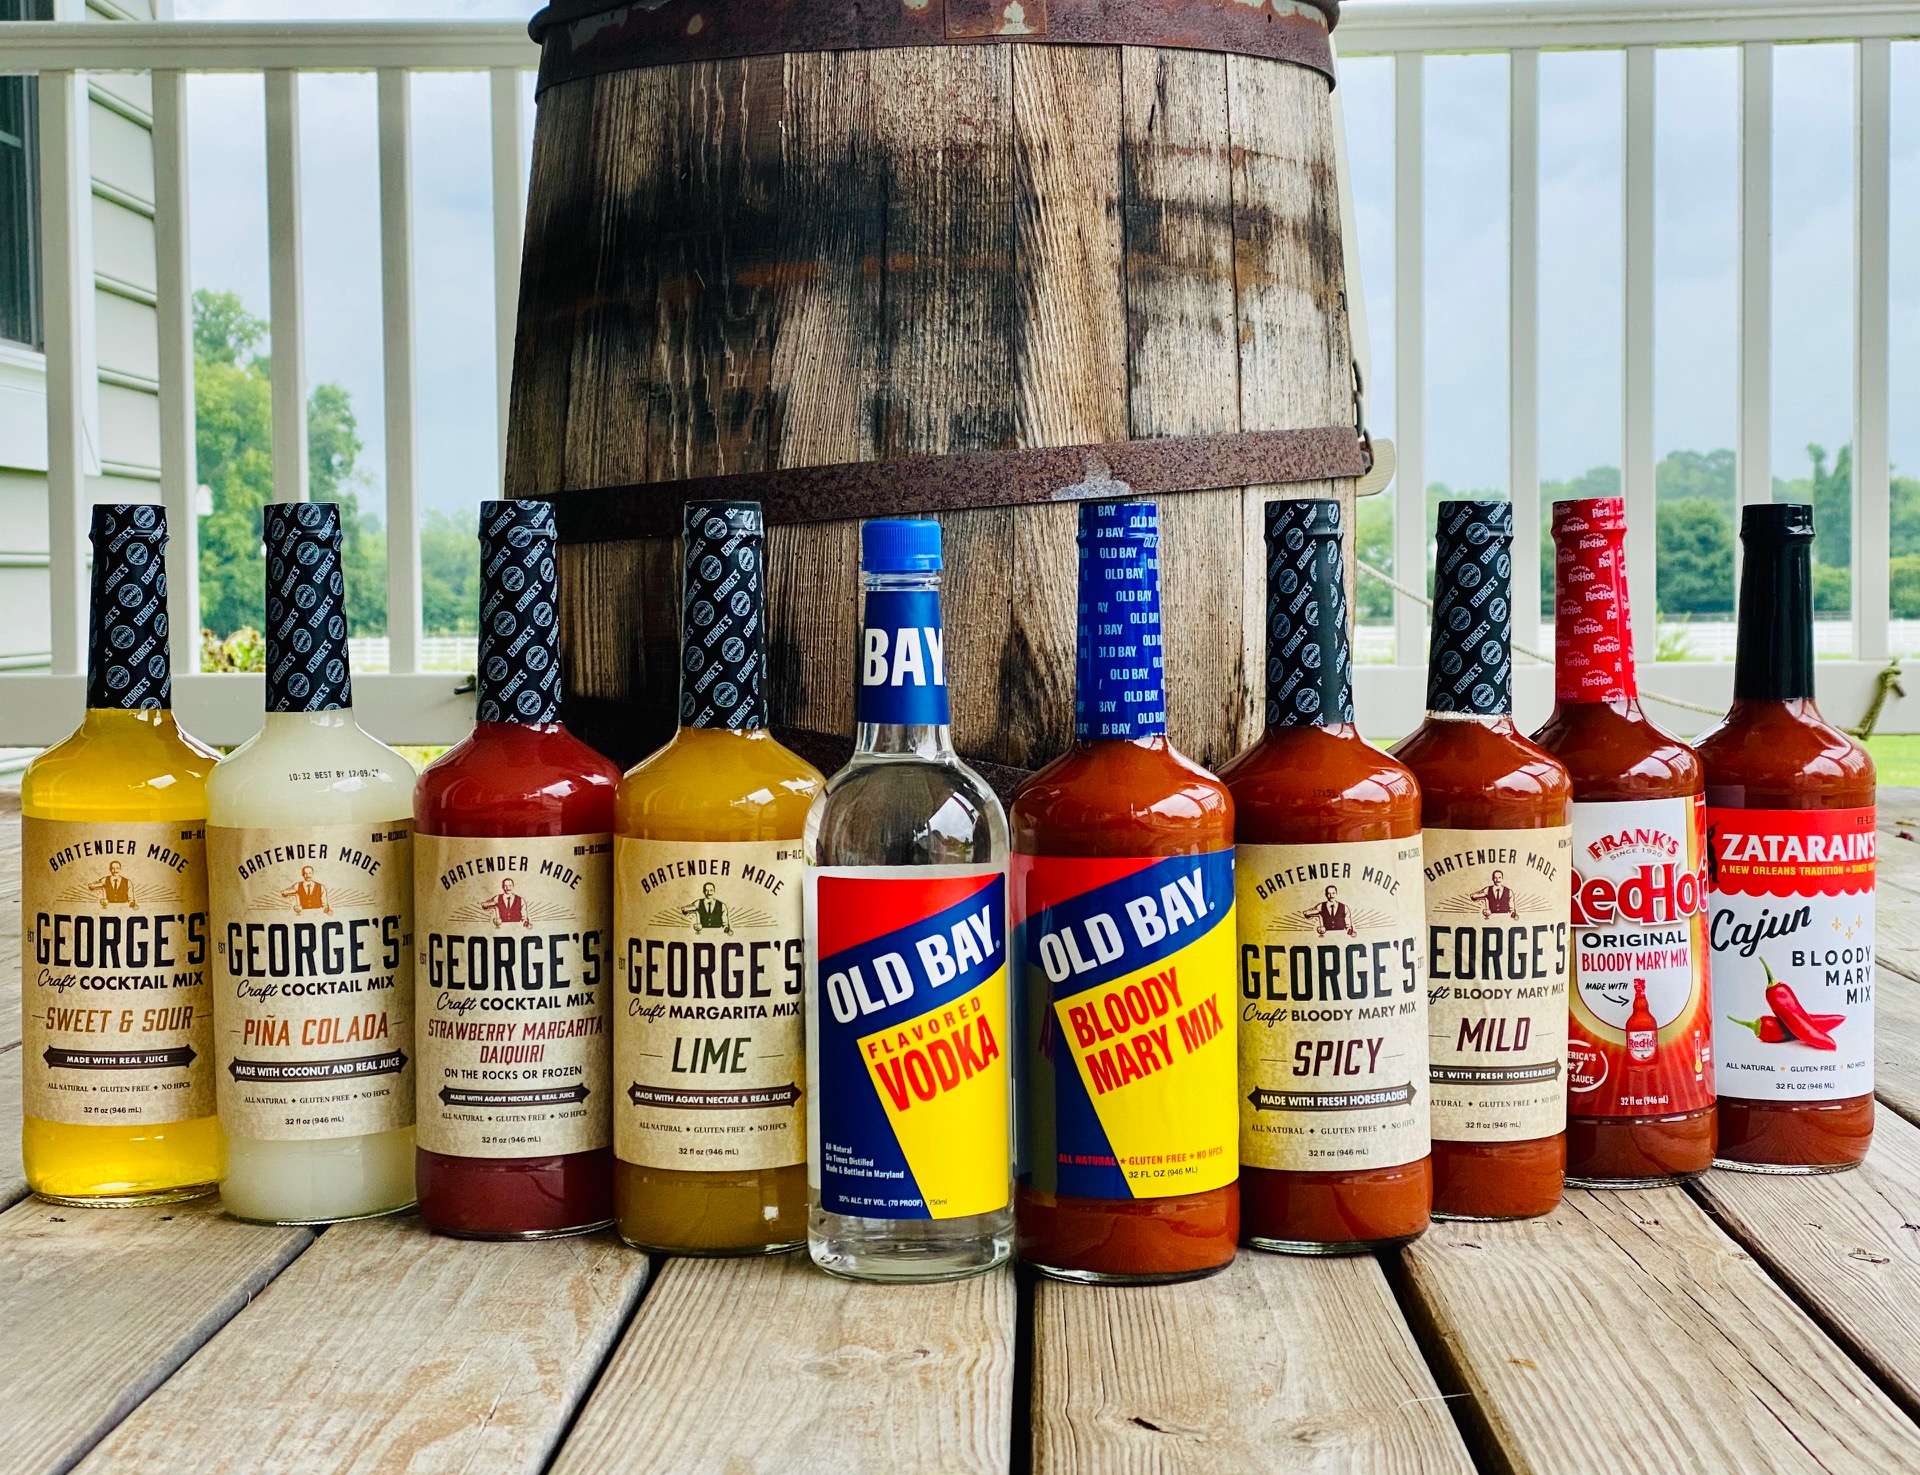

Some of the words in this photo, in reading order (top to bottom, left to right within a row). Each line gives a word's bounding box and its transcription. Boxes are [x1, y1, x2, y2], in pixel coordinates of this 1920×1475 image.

[1100, 548, 1117, 558] OLD
[1119, 547, 1137, 558] BAY
[312, 551, 336, 584] GEORGE'S
[515, 580, 543, 613] GEORGE'S
[713, 569, 741, 602] GEORGE'S
[863, 627, 943, 686] BAY
[1110, 669, 1129, 680] OLD
[1132, 668, 1148, 679] BAY
[289, 773, 310, 781] 10:32
[315, 771, 331, 779] BEST
[49, 840, 136, 872] BARTENDER
[147, 844, 189, 873] MADE
[1587, 828, 1679, 861] FRANK'S
[1610, 849, 1637, 860] SINCE
[1642, 848, 1662, 858] 1920
[238, 844, 328, 879] BARTENDER
[339, 847, 381, 876] MADE
[441, 856, 528, 890] BARTENDER
[540, 859, 582, 890] MADE
[1424, 849, 1517, 882] BARTENDER
[1526, 852, 1557, 882] MADE
[1730, 865, 1749, 874] NEW
[1753, 866, 1796, 875] ORLEANS
[1800, 866, 1843, 875] TRADITION
[641, 860, 730, 894] BARTENDER
[742, 864, 784, 896] MADE
[1256, 862, 1351, 900] BARTENDER
[1362, 866, 1400, 896] MADE
[1039, 912, 1124, 982] OLD
[1125, 867, 1208, 948] BAY
[1711, 905, 1811, 957] Cajun
[37, 912, 206, 968] GEORGE'S
[228, 915, 400, 977] GEORGE'S
[1429, 922, 1566, 980] EORGE'S
[1582, 931, 1687, 948] ORIGINAL
[429, 930, 600, 991] GEORGE'S
[628, 937, 802, 998] GEORGE'S
[826, 952, 914, 1024] OLD
[915, 904, 995, 989] BAY
[1241, 937, 1415, 1001] GEORGE'S
[1582, 953, 1632, 972] BLOODY
[1636, 951, 1667, 971] MARY
[1671, 948, 1688, 967] MIX
[1792, 946, 1871, 967] BLOODY
[38, 969, 76, 993] Craft
[80, 975, 168, 990] COCKTAIL
[173, 971, 204, 987] MIX
[237, 980, 278, 1003] Craft
[282, 980, 362, 996] COCKTAIL
[367, 975, 395, 991] MIX
[1826, 966, 1871, 986] MARY
[437, 992, 476, 1016] Craft
[480, 996, 561, 1010] COCKTAIL
[567, 992, 595, 1007] MIX
[1427, 986, 1450, 1004] aft
[1454, 988, 1512, 1000] BLOODY
[1517, 986, 1549, 999] MARY
[1551, 982, 1564, 994] MIX
[1847, 986, 1870, 1005] MIX
[46, 1007, 112, 1033] SWEET
[119, 1010, 133, 1033] &
[142, 1006, 193, 1032] SOUR
[629, 998, 666, 1023] Craft
[669, 1005, 767, 1019] MARGARITA
[773, 1002, 800, 1017] MIX
[1068, 966, 1183, 1049] BLOODY
[1243, 1003, 1287, 1028] Craft
[1292, 1009, 1353, 1021] BLOODY
[1358, 1005, 1395, 1020] MARY
[1400, 1001, 1416, 1014] MIX
[243, 1015, 290, 1046] PIÑA
[301, 1012, 388, 1045] COLADA
[428, 1019, 517, 1041] STRAWBERRY
[522, 1016, 602, 1041] MARGARITA
[867, 996, 981, 1059] FLAVORED
[1456, 1017, 1531, 1052] MILD
[480, 1045, 545, 1065] DAIQUIRI
[671, 1037, 751, 1074] LIME
[1085, 1024, 1174, 1095] MARY
[1176, 993, 1224, 1054] MIX
[1292, 1037, 1384, 1076] SPICY
[1568, 1052, 1596, 1061] ERICA'S
[67, 1056, 90, 1064] MADE
[119, 1056, 141, 1064] REAL
[144, 1055, 168, 1063] JUICE
[236, 1066, 255, 1076] MADE
[257, 1067, 280, 1077] WITH
[282, 1066, 329, 1077] COCONUT
[332, 1064, 354, 1075] AND
[356, 1060, 377, 1072] REAL
[379, 1057, 399, 1069] JUICE
[445, 1068, 458, 1078] ON
[462, 1069, 478, 1079] THE
[483, 1070, 518, 1080] ROCKS
[523, 1069, 537, 1079] OR
[543, 1066, 582, 1078] FROZEN
[875, 1014, 999, 1112] VODKA
[1476, 1071, 1503, 1079] FRESH
[1507, 1067, 1555, 1078] HORSERADISH
[1571, 1074, 1594, 1084] SAUCE
[635, 1091, 652, 1099] MADE
[654, 1093, 674, 1102] WITH
[676, 1095, 703, 1103] AGAVE
[742, 1095, 748, 1103] &
[751, 1094, 770, 1102] REAL
[772, 1092, 791, 1101] JUICE
[1261, 1095, 1286, 1106] MADE
[1288, 1096, 1314, 1106] WITH
[1317, 1096, 1347, 1106] FRESH
[1350, 1089, 1408, 1105] HORSERADISH
[825, 1163, 837, 1172] Made
[844, 1167, 865, 1177] Bottled
[866, 1169, 872, 1178] in
[874, 1169, 904, 1179] Maryland
[833, 1154, 847, 1164] Times
[849, 1157, 874, 1167] Distilled
[1058, 1153, 1072, 1163] ALL
[1076, 1156, 1116, 1166] NATURAL
[1129, 1156, 1163, 1166] GLUTEN
[1166, 1153, 1186, 1163] FREE
[1197, 1152, 1206, 1160] NO
[1129, 1171, 1139, 1179] 32
[1167, 1168, 1183, 1177] (946
[1185, 1167, 1198, 1175] ML)
[851, 1196, 863, 1204] ALC.
[864, 1197, 872, 1205] BY
[873, 1198, 887, 1206] VOL.
[888, 1199, 898, 1207] (70
[899, 1199, 923, 1207] PROOF)
[929, 1198, 947, 1206] 750ml
